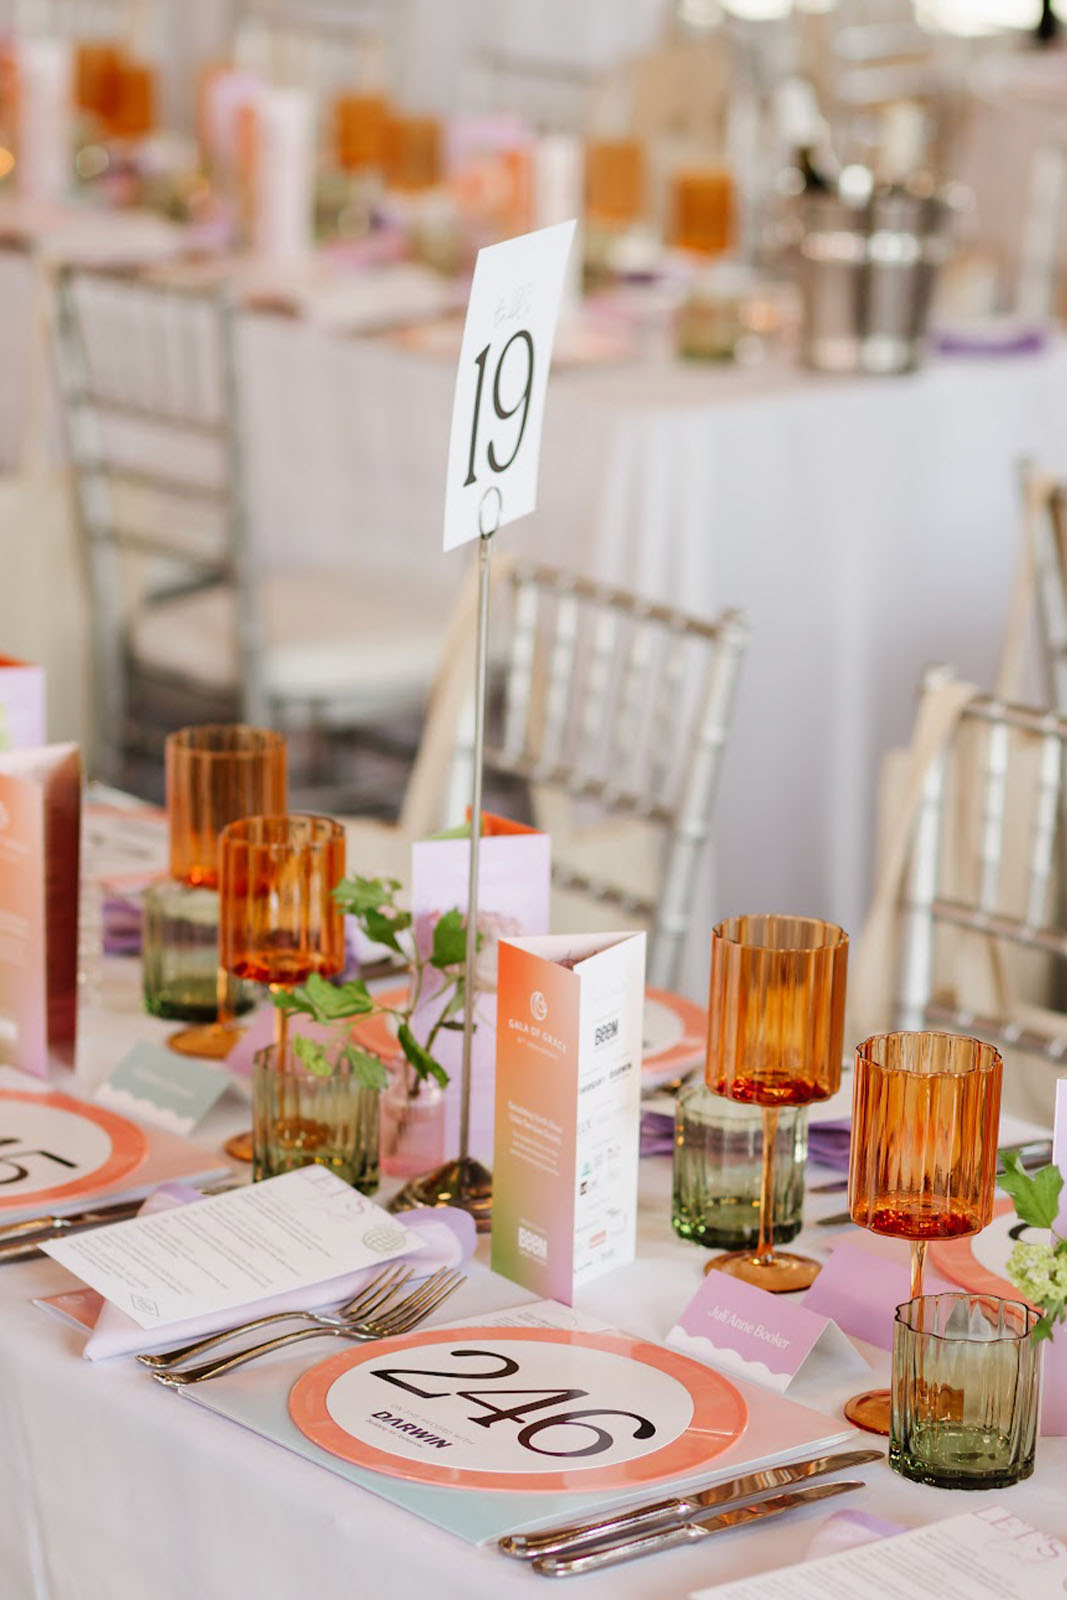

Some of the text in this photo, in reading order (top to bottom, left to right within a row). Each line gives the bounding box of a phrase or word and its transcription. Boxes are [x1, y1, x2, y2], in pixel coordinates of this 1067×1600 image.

[463, 329, 534, 487] 19
[369, 1349, 656, 1458] 246
[371, 1411, 453, 1449] DARWIN
